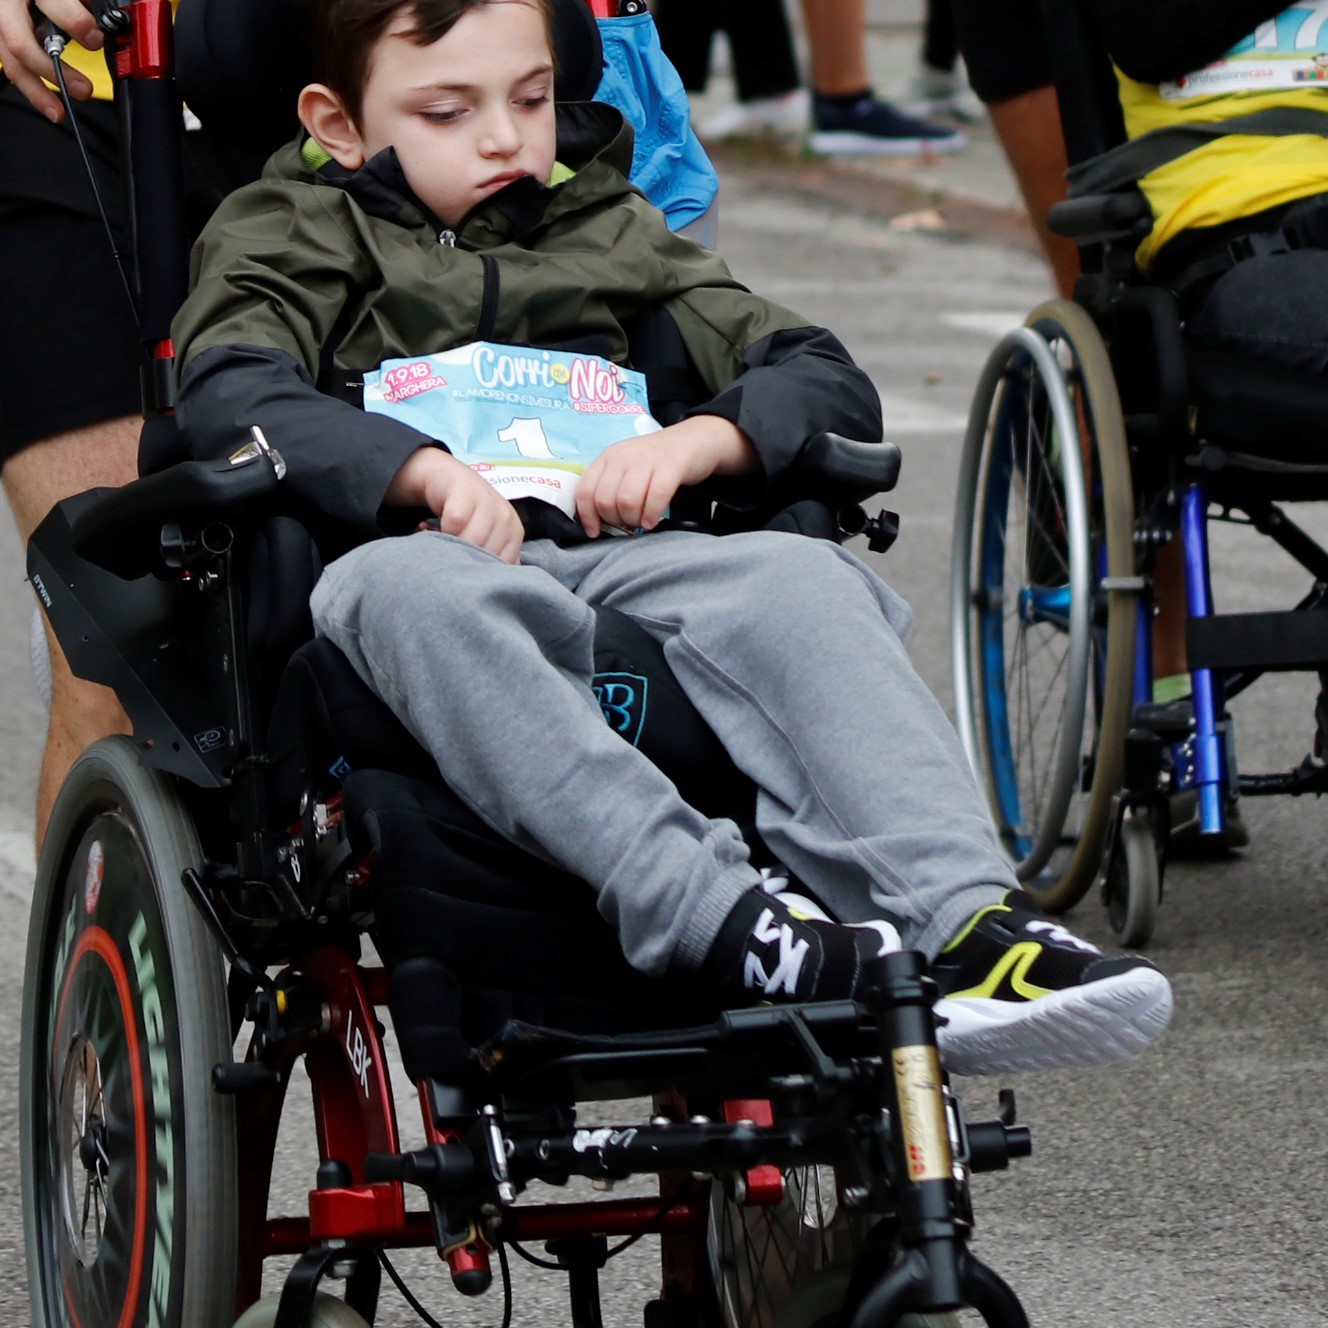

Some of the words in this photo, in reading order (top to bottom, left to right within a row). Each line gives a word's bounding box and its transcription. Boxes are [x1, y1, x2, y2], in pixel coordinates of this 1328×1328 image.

[387, 363, 430, 387] 1.9.18
[472, 346, 555, 389] Corri
[570, 357, 626, 404] Noi
[383, 376, 447, 403] MARGHERA
[497, 417, 563, 459] 1
[489, 475, 562, 489] sionecasa
